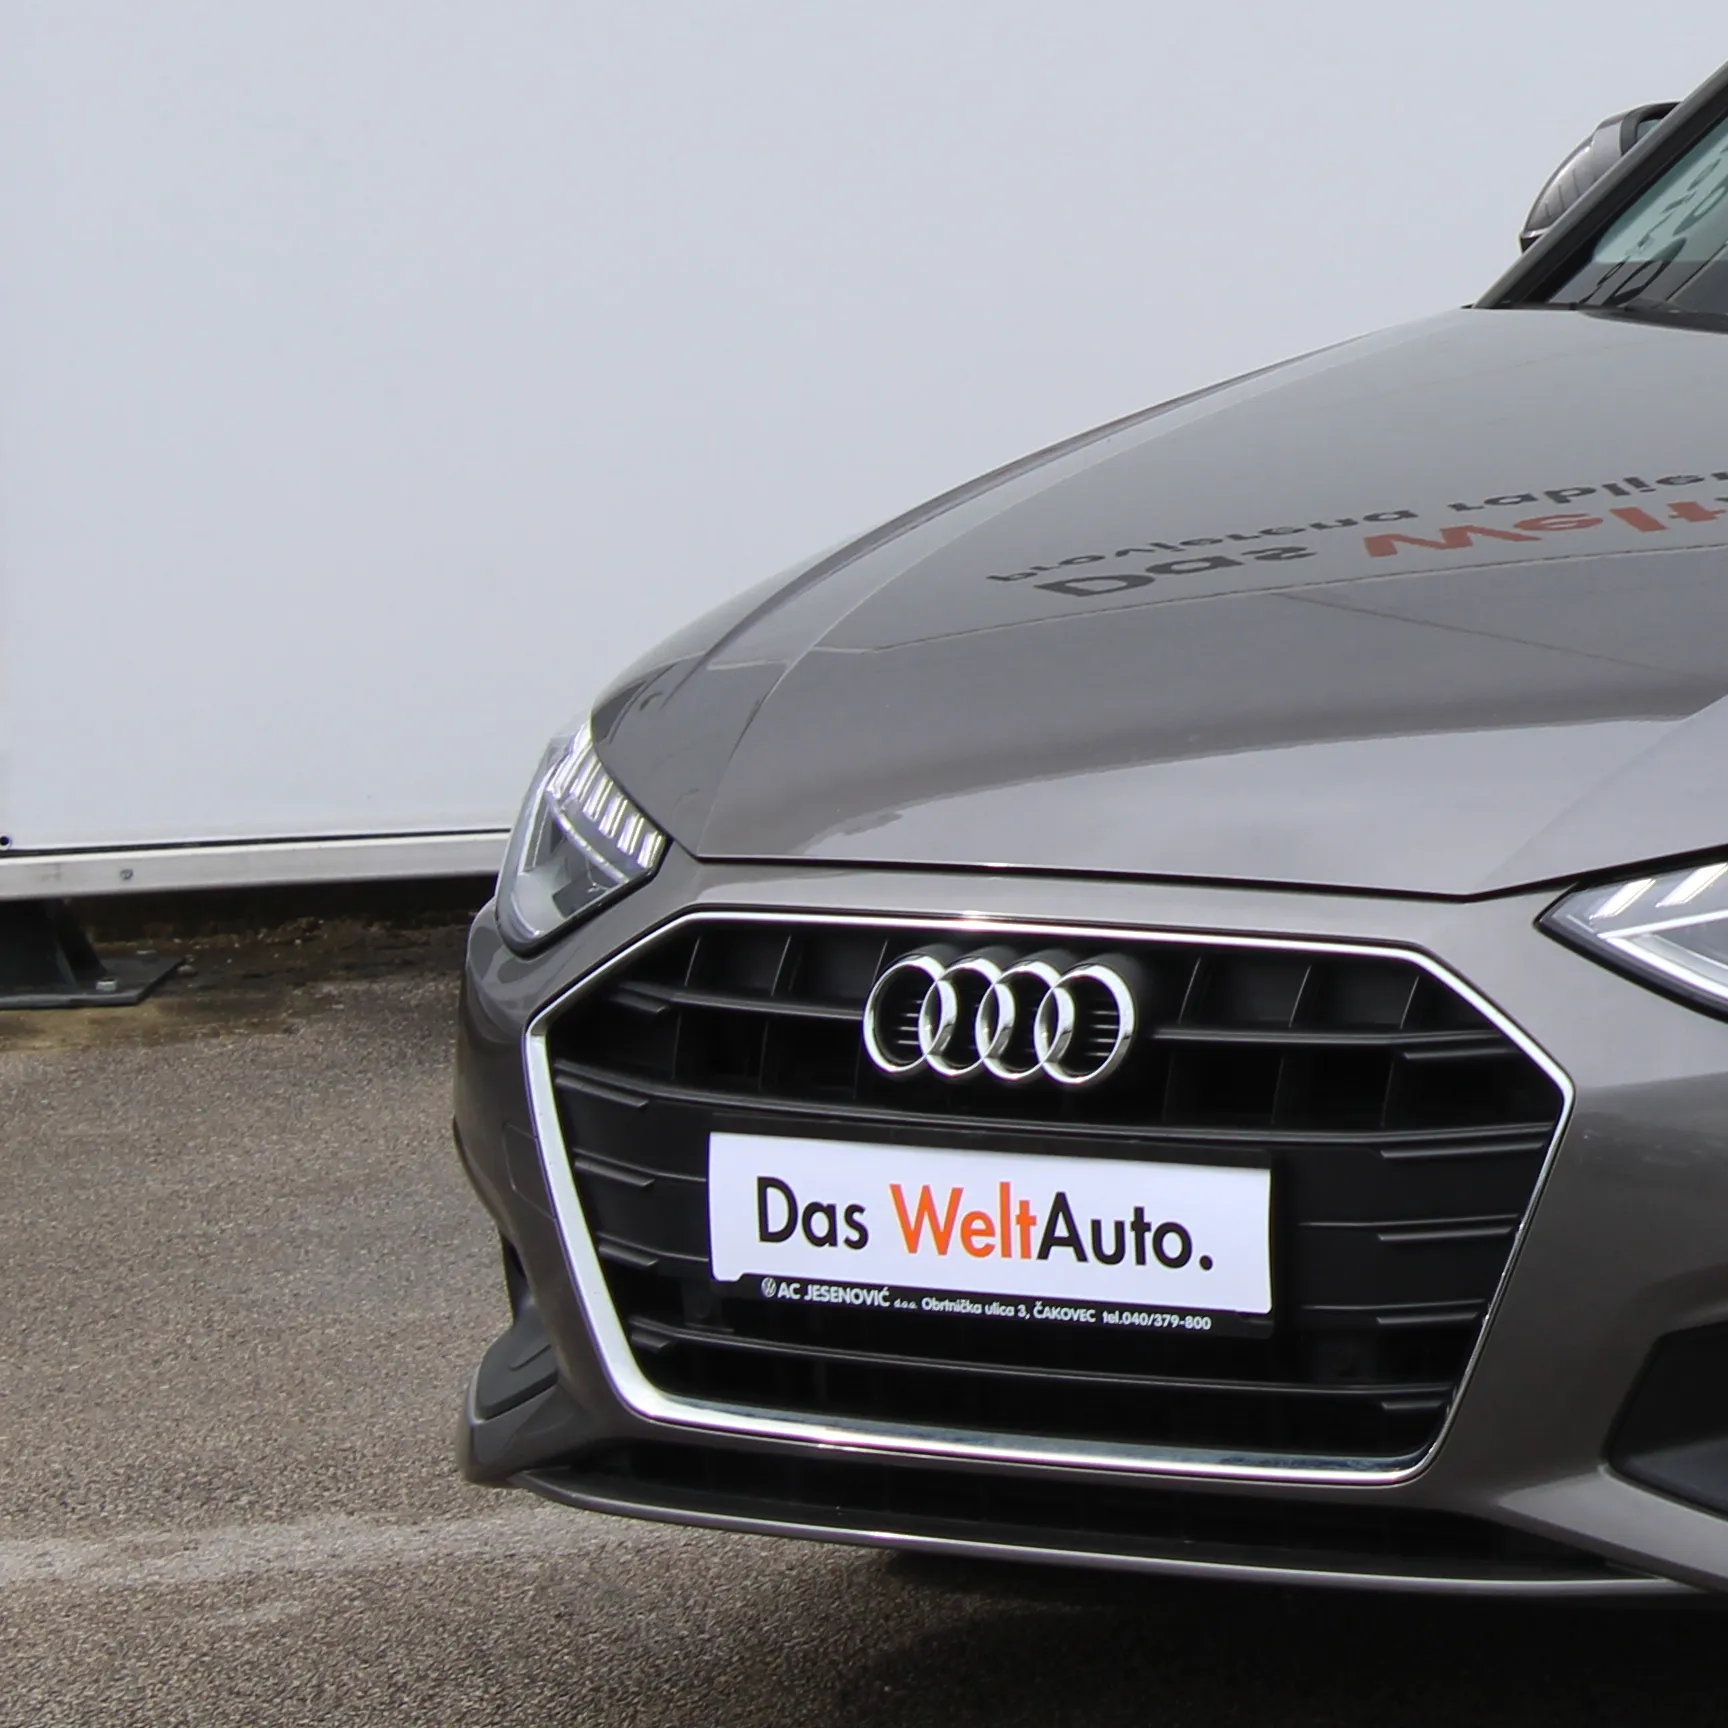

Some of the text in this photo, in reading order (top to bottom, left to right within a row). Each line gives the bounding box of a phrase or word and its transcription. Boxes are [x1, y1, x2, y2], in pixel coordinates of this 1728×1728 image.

[756, 1176, 1214, 1271] Das WeltAuto.
[778, 1281, 801, 1300] AC
[804, 1284, 891, 1308] JESENOVIĆ
[921, 1297, 982, 1315] Obrtnička
[985, 1301, 1015, 1317] ulica
[1033, 1301, 1096, 1323] ČAKOVEC
[1102, 1310, 1212, 1330] tel.040/379-800
